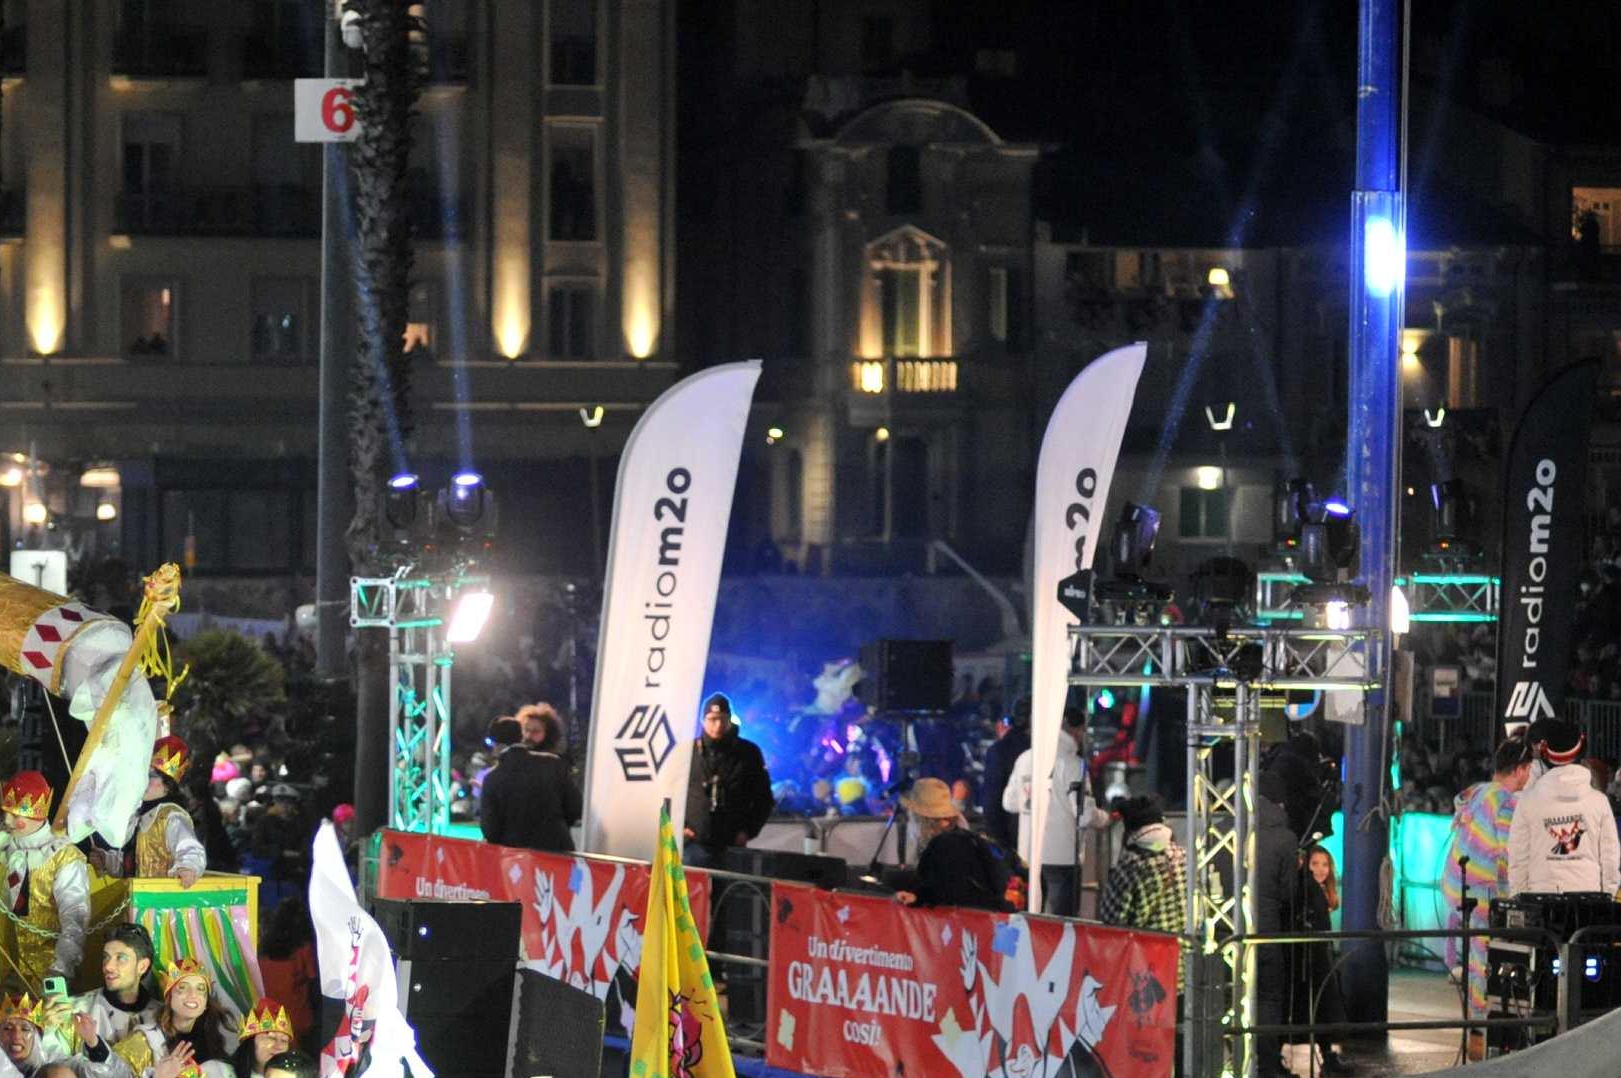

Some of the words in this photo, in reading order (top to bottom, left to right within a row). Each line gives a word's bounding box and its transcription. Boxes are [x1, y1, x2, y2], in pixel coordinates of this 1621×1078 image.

[322, 86, 355, 133] 6
[644, 466, 692, 689] radiom2o
[1521, 458, 1557, 668] radiom2o
[415, 876, 432, 897] Un
[808, 935, 828, 959] Un
[830, 938, 914, 972] divertimento
[788, 960, 938, 1024] GRAAAANDE
